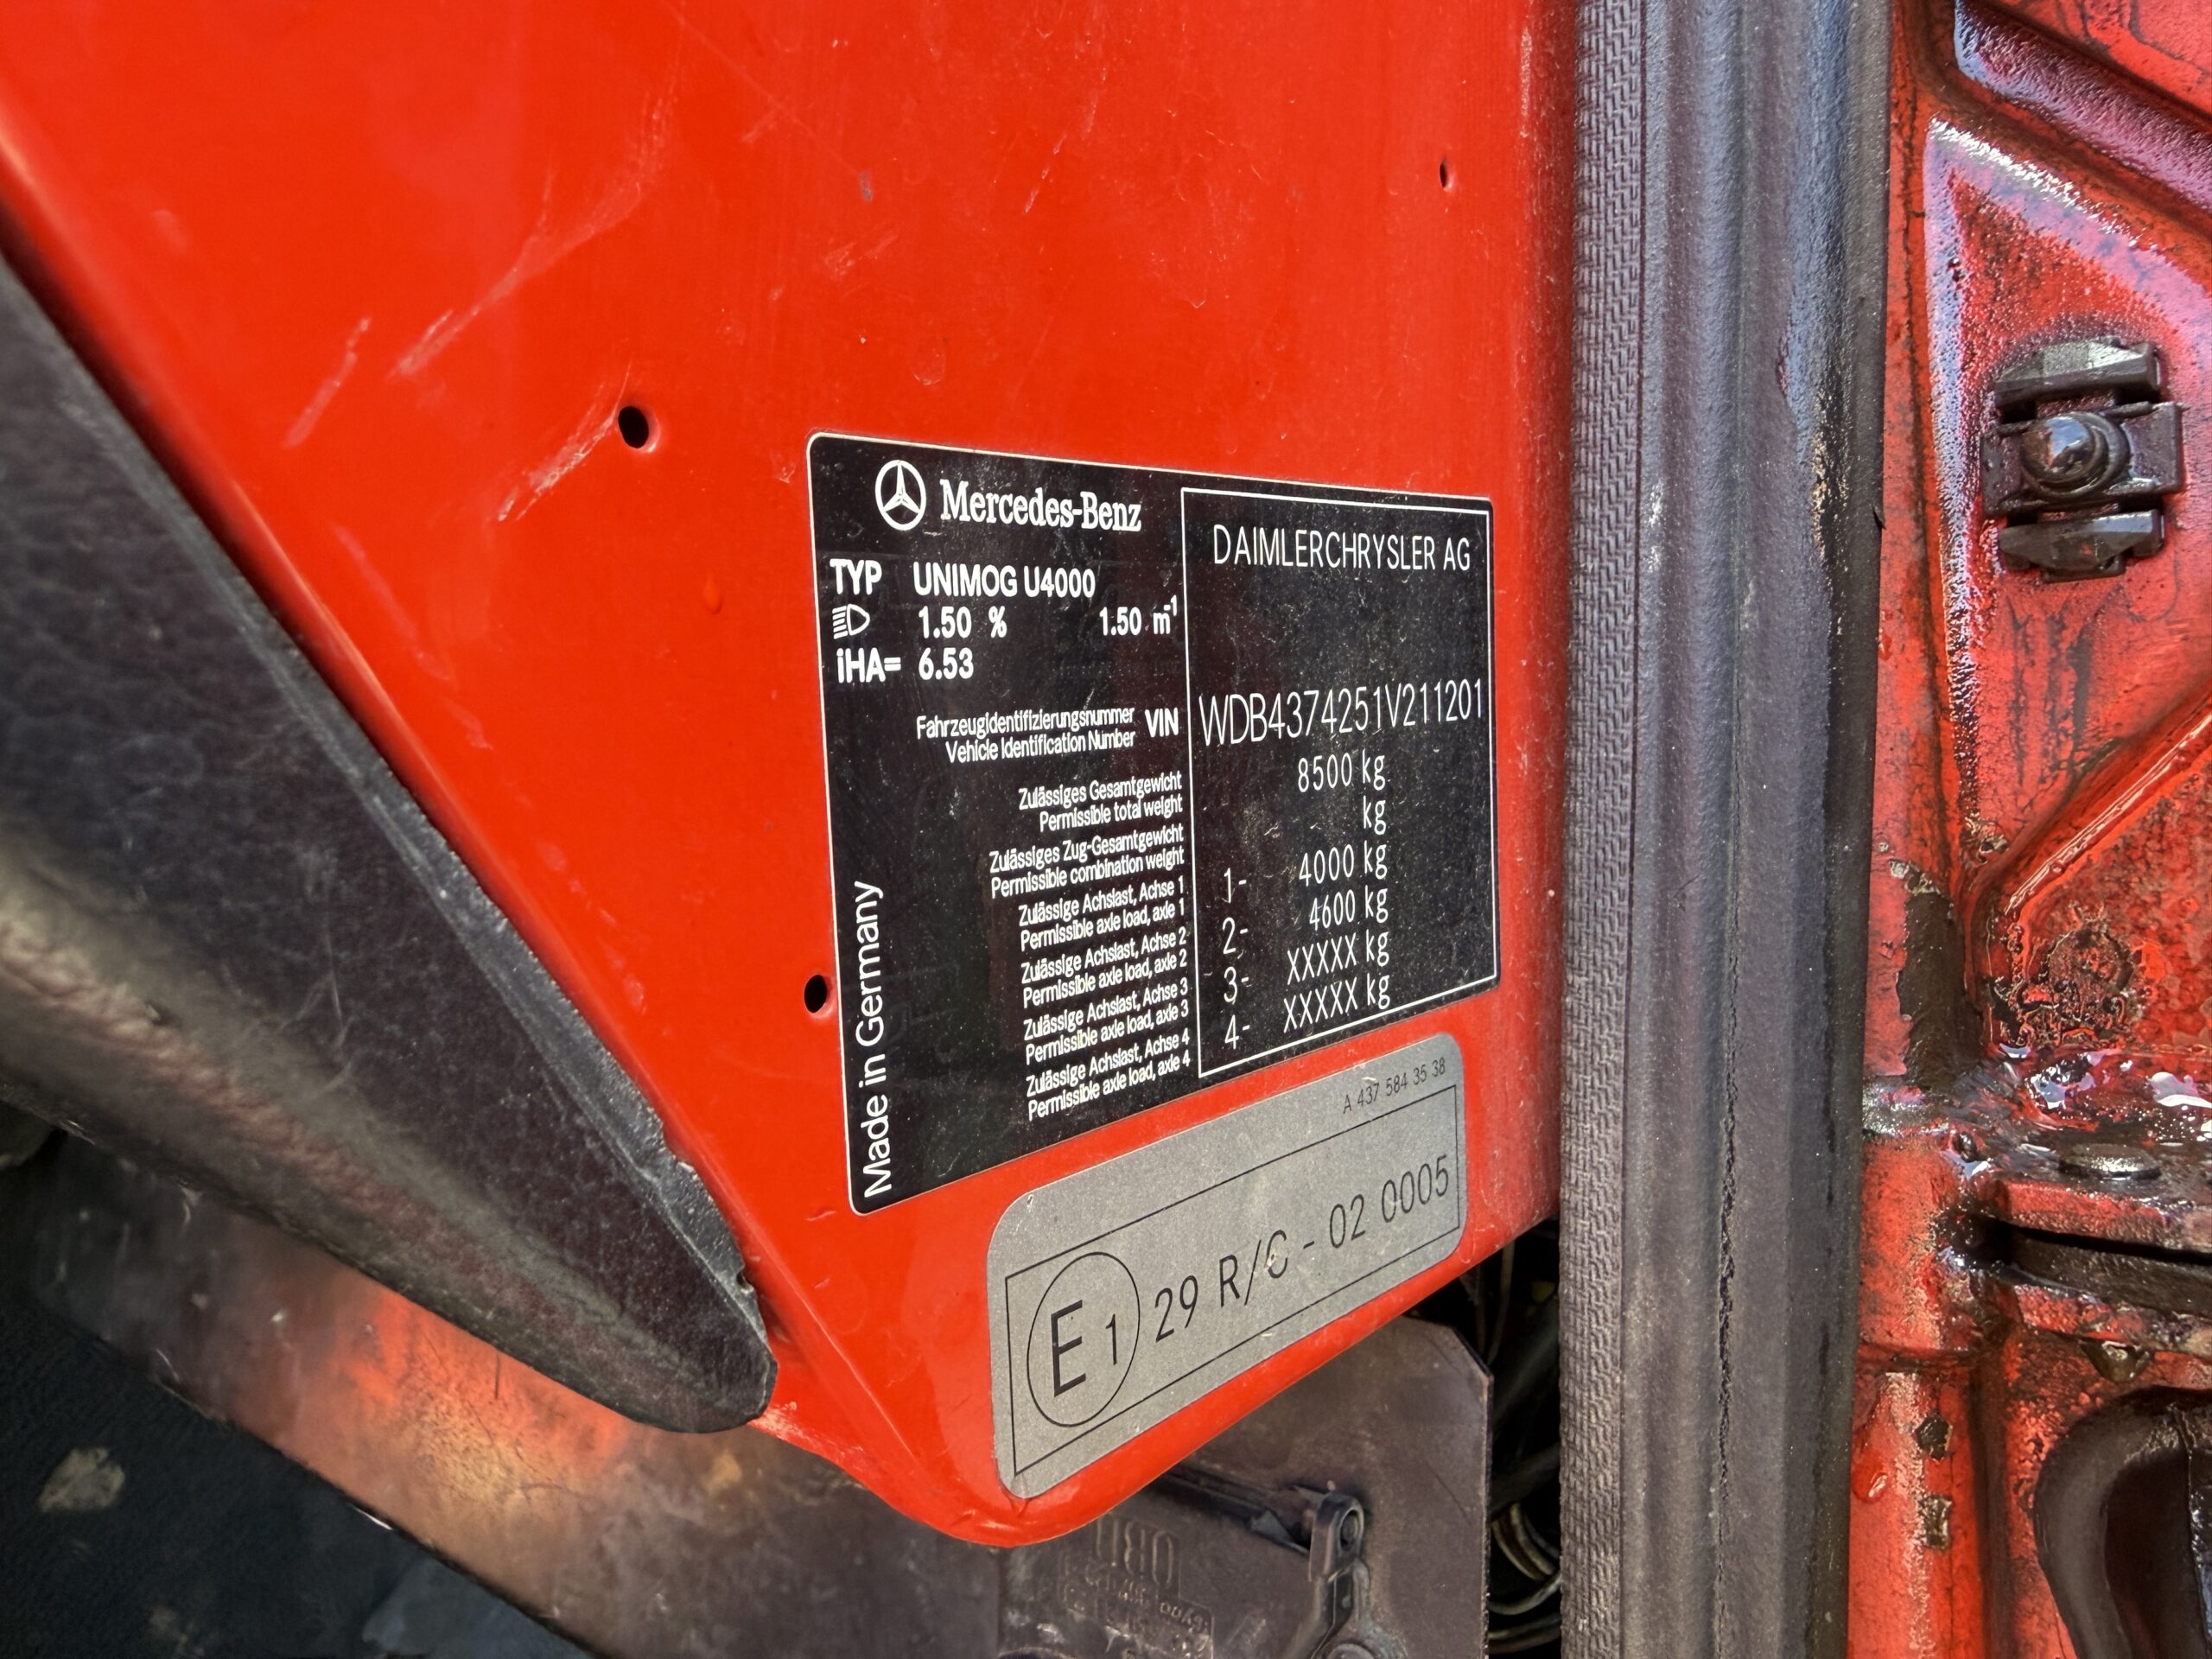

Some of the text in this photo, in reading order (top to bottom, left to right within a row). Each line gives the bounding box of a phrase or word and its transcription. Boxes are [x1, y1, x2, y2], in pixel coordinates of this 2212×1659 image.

[940, 480, 1141, 531] Mercedes-Benz
[1214, 524, 1470, 570] DAIMLERCHRYSLER AG
[830, 559, 1096, 597] TYP UNIMOG U4000
[918, 607, 971, 639] 1.50
[1100, 607, 1141, 635] 1.50
[836, 647, 974, 683] iHA= 6.53
[917, 678, 1481, 746] Fahrzeugidentifizierungsnummer VIN WDB4374251V211201
[946, 731, 1135, 763] Vehicle Identification Number
[1298, 749, 1385, 792] 8500 kg
[1019, 771, 1182, 810] Zulässiges Gesamtgewicht
[1039, 793, 1183, 832] Permissible total weight
[1363, 795, 1386, 835] kg
[989, 823, 1184, 874] Zulässiges Zug-Gesamtgewicht
[991, 847, 1185, 899] Permissible combination weight
[1300, 840, 1387, 887] 4000 kg
[1019, 898, 1079, 926] Zulässige
[1082, 885, 1137, 913] Achslast,
[1139, 880, 1174, 902] Achse
[1178, 875, 1184, 893] 1
[1020, 898, 1185, 951] Permissible axle load, axle 1
[1309, 885, 1389, 931] 4600 kg
[1021, 953, 1082, 984] Zulässige
[1084, 938, 1139, 969] Achslast,
[1141, 931, 1176, 955] Achse
[1179, 926, 1186, 945] 2
[1023, 948, 1187, 1009] Permissible axle load, axle 2
[1287, 930, 1389, 985] XXXXX kg
[1023, 1008, 1084, 1041] Zulässige
[1087, 991, 1141, 1024] Achslast,
[1142, 983, 1178, 1007] Achse
[1179, 976, 1188, 995] 3
[1284, 973, 1390, 1033] XXXXX kg
[854, 880, 893, 1198] Made in Germany
[1026, 998, 1189, 1065] Permissible axle load, axle 3
[1026, 1064, 1086, 1097] Zulässige
[1089, 1042, 1143, 1077] Achslast,
[1144, 1032, 1179, 1058] Achse
[1181, 1027, 1190, 1046] 4
[1028, 1049, 1191, 1122] Permissible axle load, axle 4
[1343, 1057, 1446, 1114] A 437 584 35 38
[1050, 1300, 1087, 1398] E
[1105, 1313, 1117, 1365] 1
[1154, 1274, 1199, 1344] 29
[1329, 1193, 1366, 1249] 02
[1382, 1154, 1450, 1224] 0005
